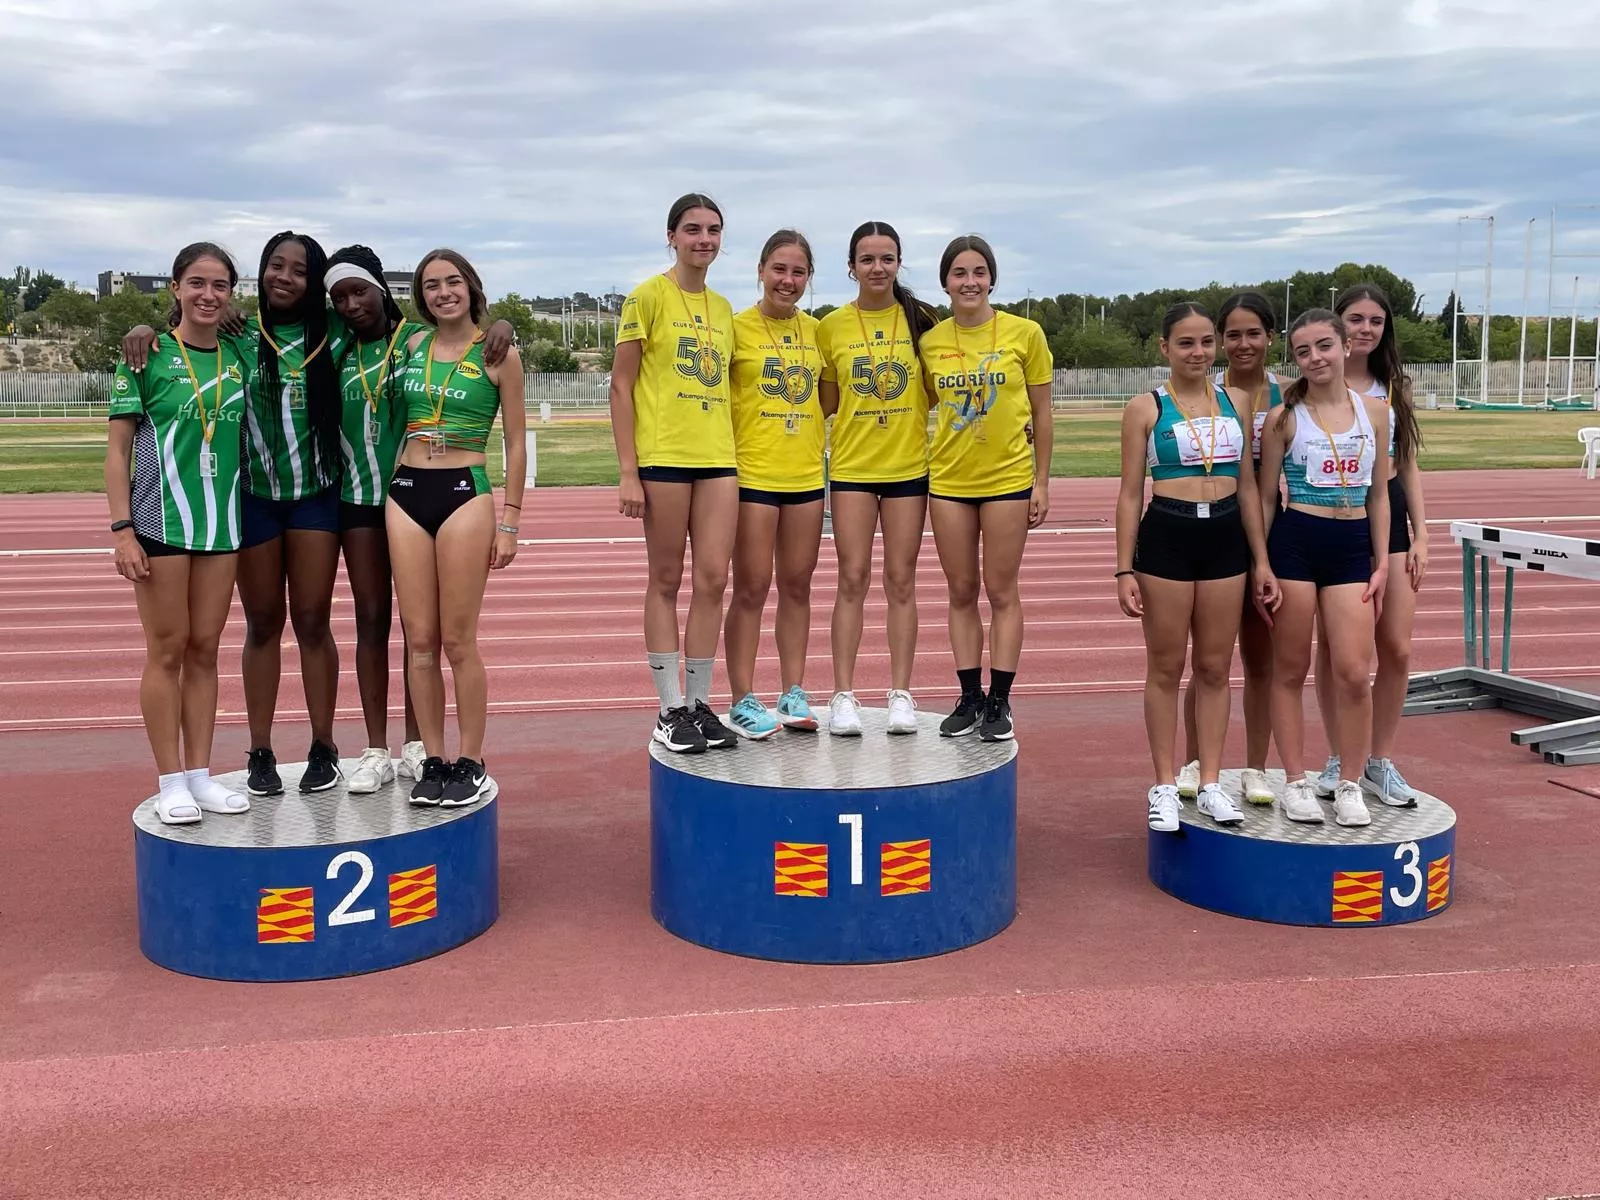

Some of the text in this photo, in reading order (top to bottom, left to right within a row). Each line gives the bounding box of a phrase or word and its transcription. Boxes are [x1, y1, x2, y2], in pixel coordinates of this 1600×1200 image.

[677, 336, 722, 387] 50
[763, 356, 813, 404] 50
[852, 355, 908, 401] 50
[939, 373, 1006, 389] SCORPIO
[403, 379, 467, 400] Huesca
[954, 389, 987, 417] 71
[1322, 459, 1360, 474] 848
[839, 814, 863, 884] 1
[326, 851, 375, 927] 2
[1390, 841, 1422, 907] 3
